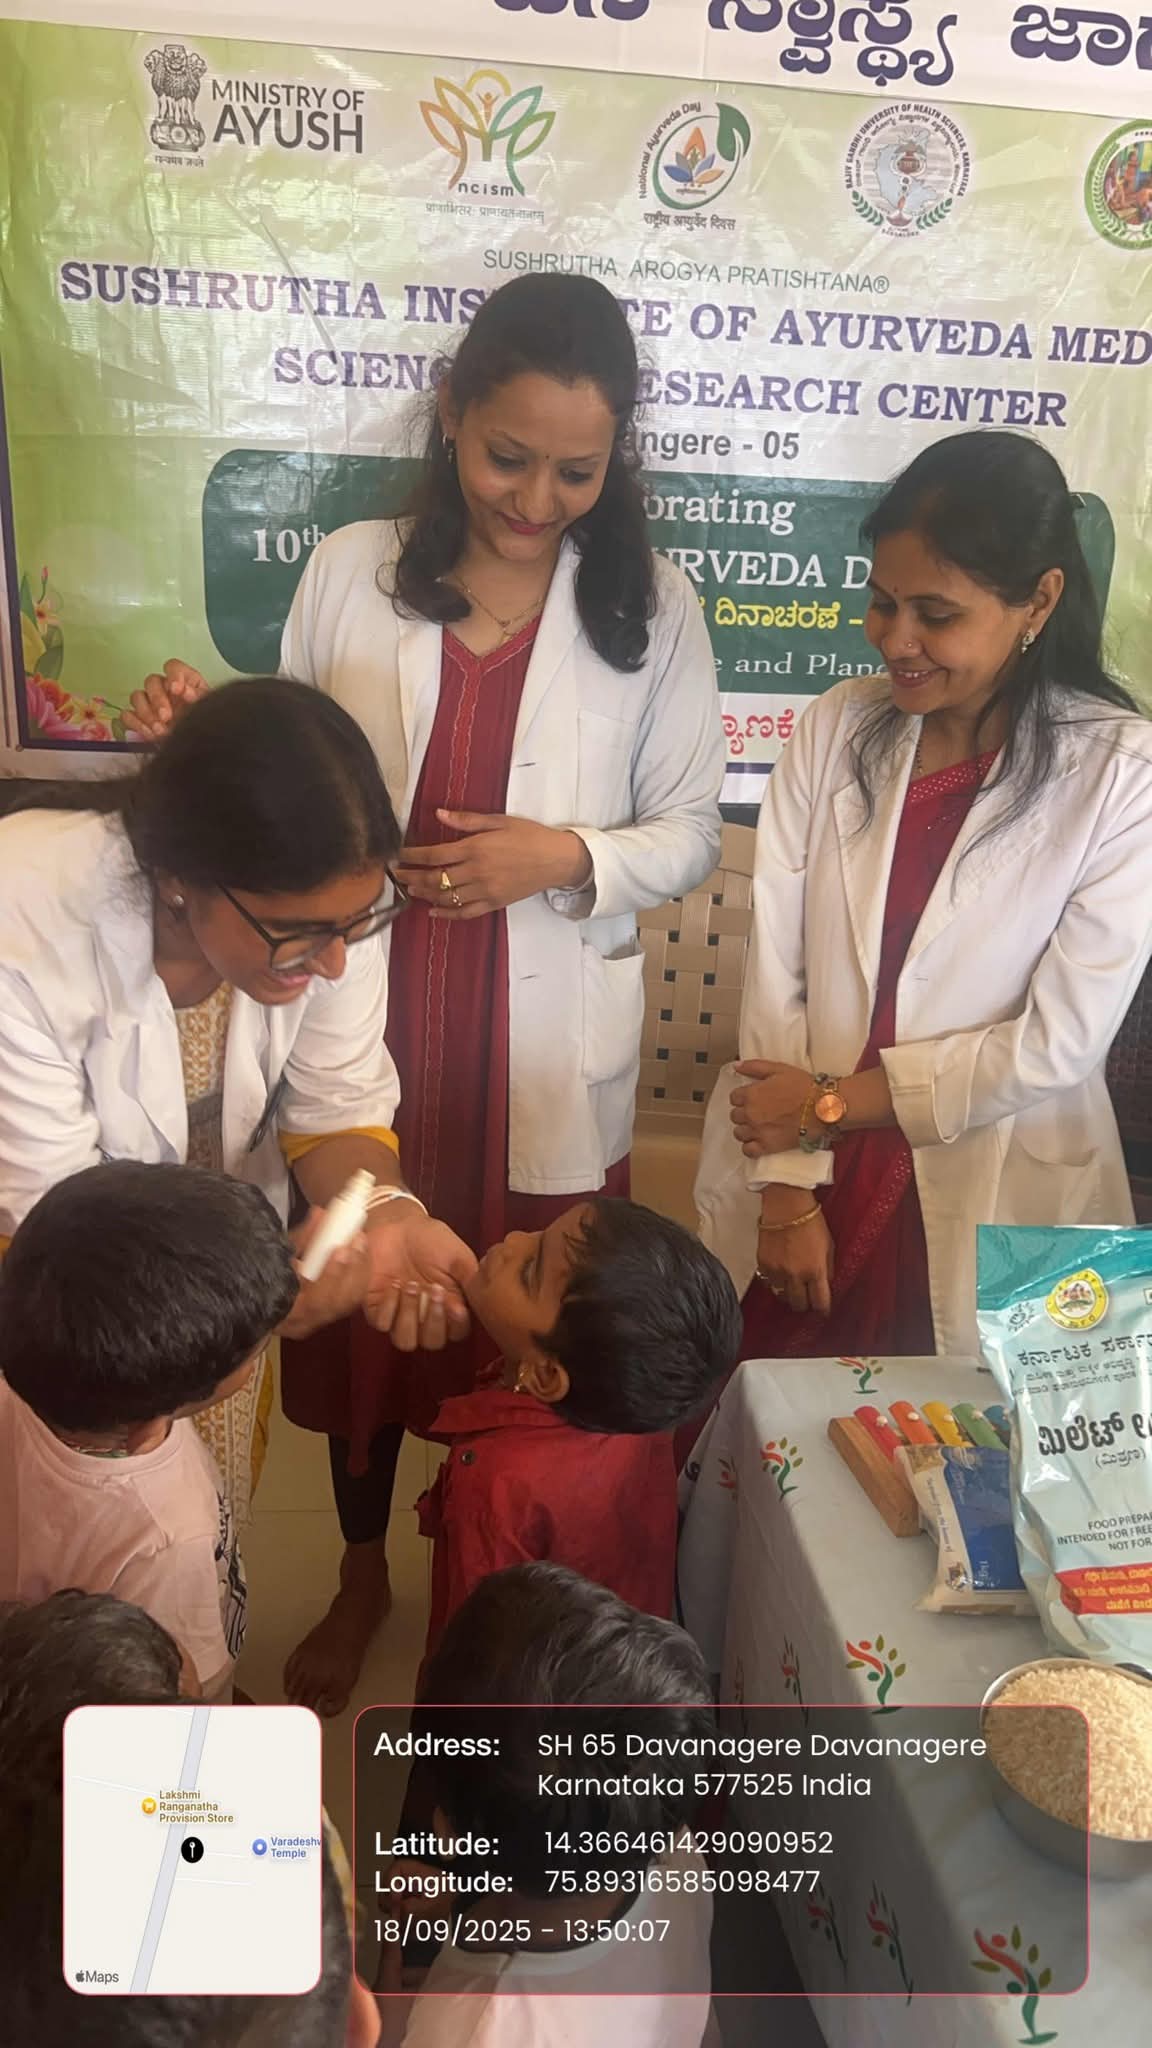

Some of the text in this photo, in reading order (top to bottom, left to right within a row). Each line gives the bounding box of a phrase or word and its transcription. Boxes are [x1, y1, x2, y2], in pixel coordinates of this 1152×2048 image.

[212, 79, 365, 111] MINISTRY OF
[682, 101, 701, 114] Day
[212, 104, 363, 153] AYUSH
[458, 182, 514, 196] ncism
[483, 250, 618, 276] SUSHRUTHA
[629, 260, 721, 284] AROGYA
[61, 261, 387, 320] SUSHRUTHA
[690, 303, 757, 342] OF
[770, 309, 1032, 360] AYURVEDA
[1048, 326, 1152, 365] MED
[878, 383, 1067, 427] CENTER
[763, 431, 800, 459] 05
[735, 652, 792, 674] and
[1038, 1411, 1125, 1456] ಮಿಲೆಟ್
[1057, 1532, 1106, 1544] INTENDED
[1108, 1528, 1128, 1539] FOR
[1088, 1518, 1117, 1530] FOOD
[1108, 1540, 1129, 1550] NOT
